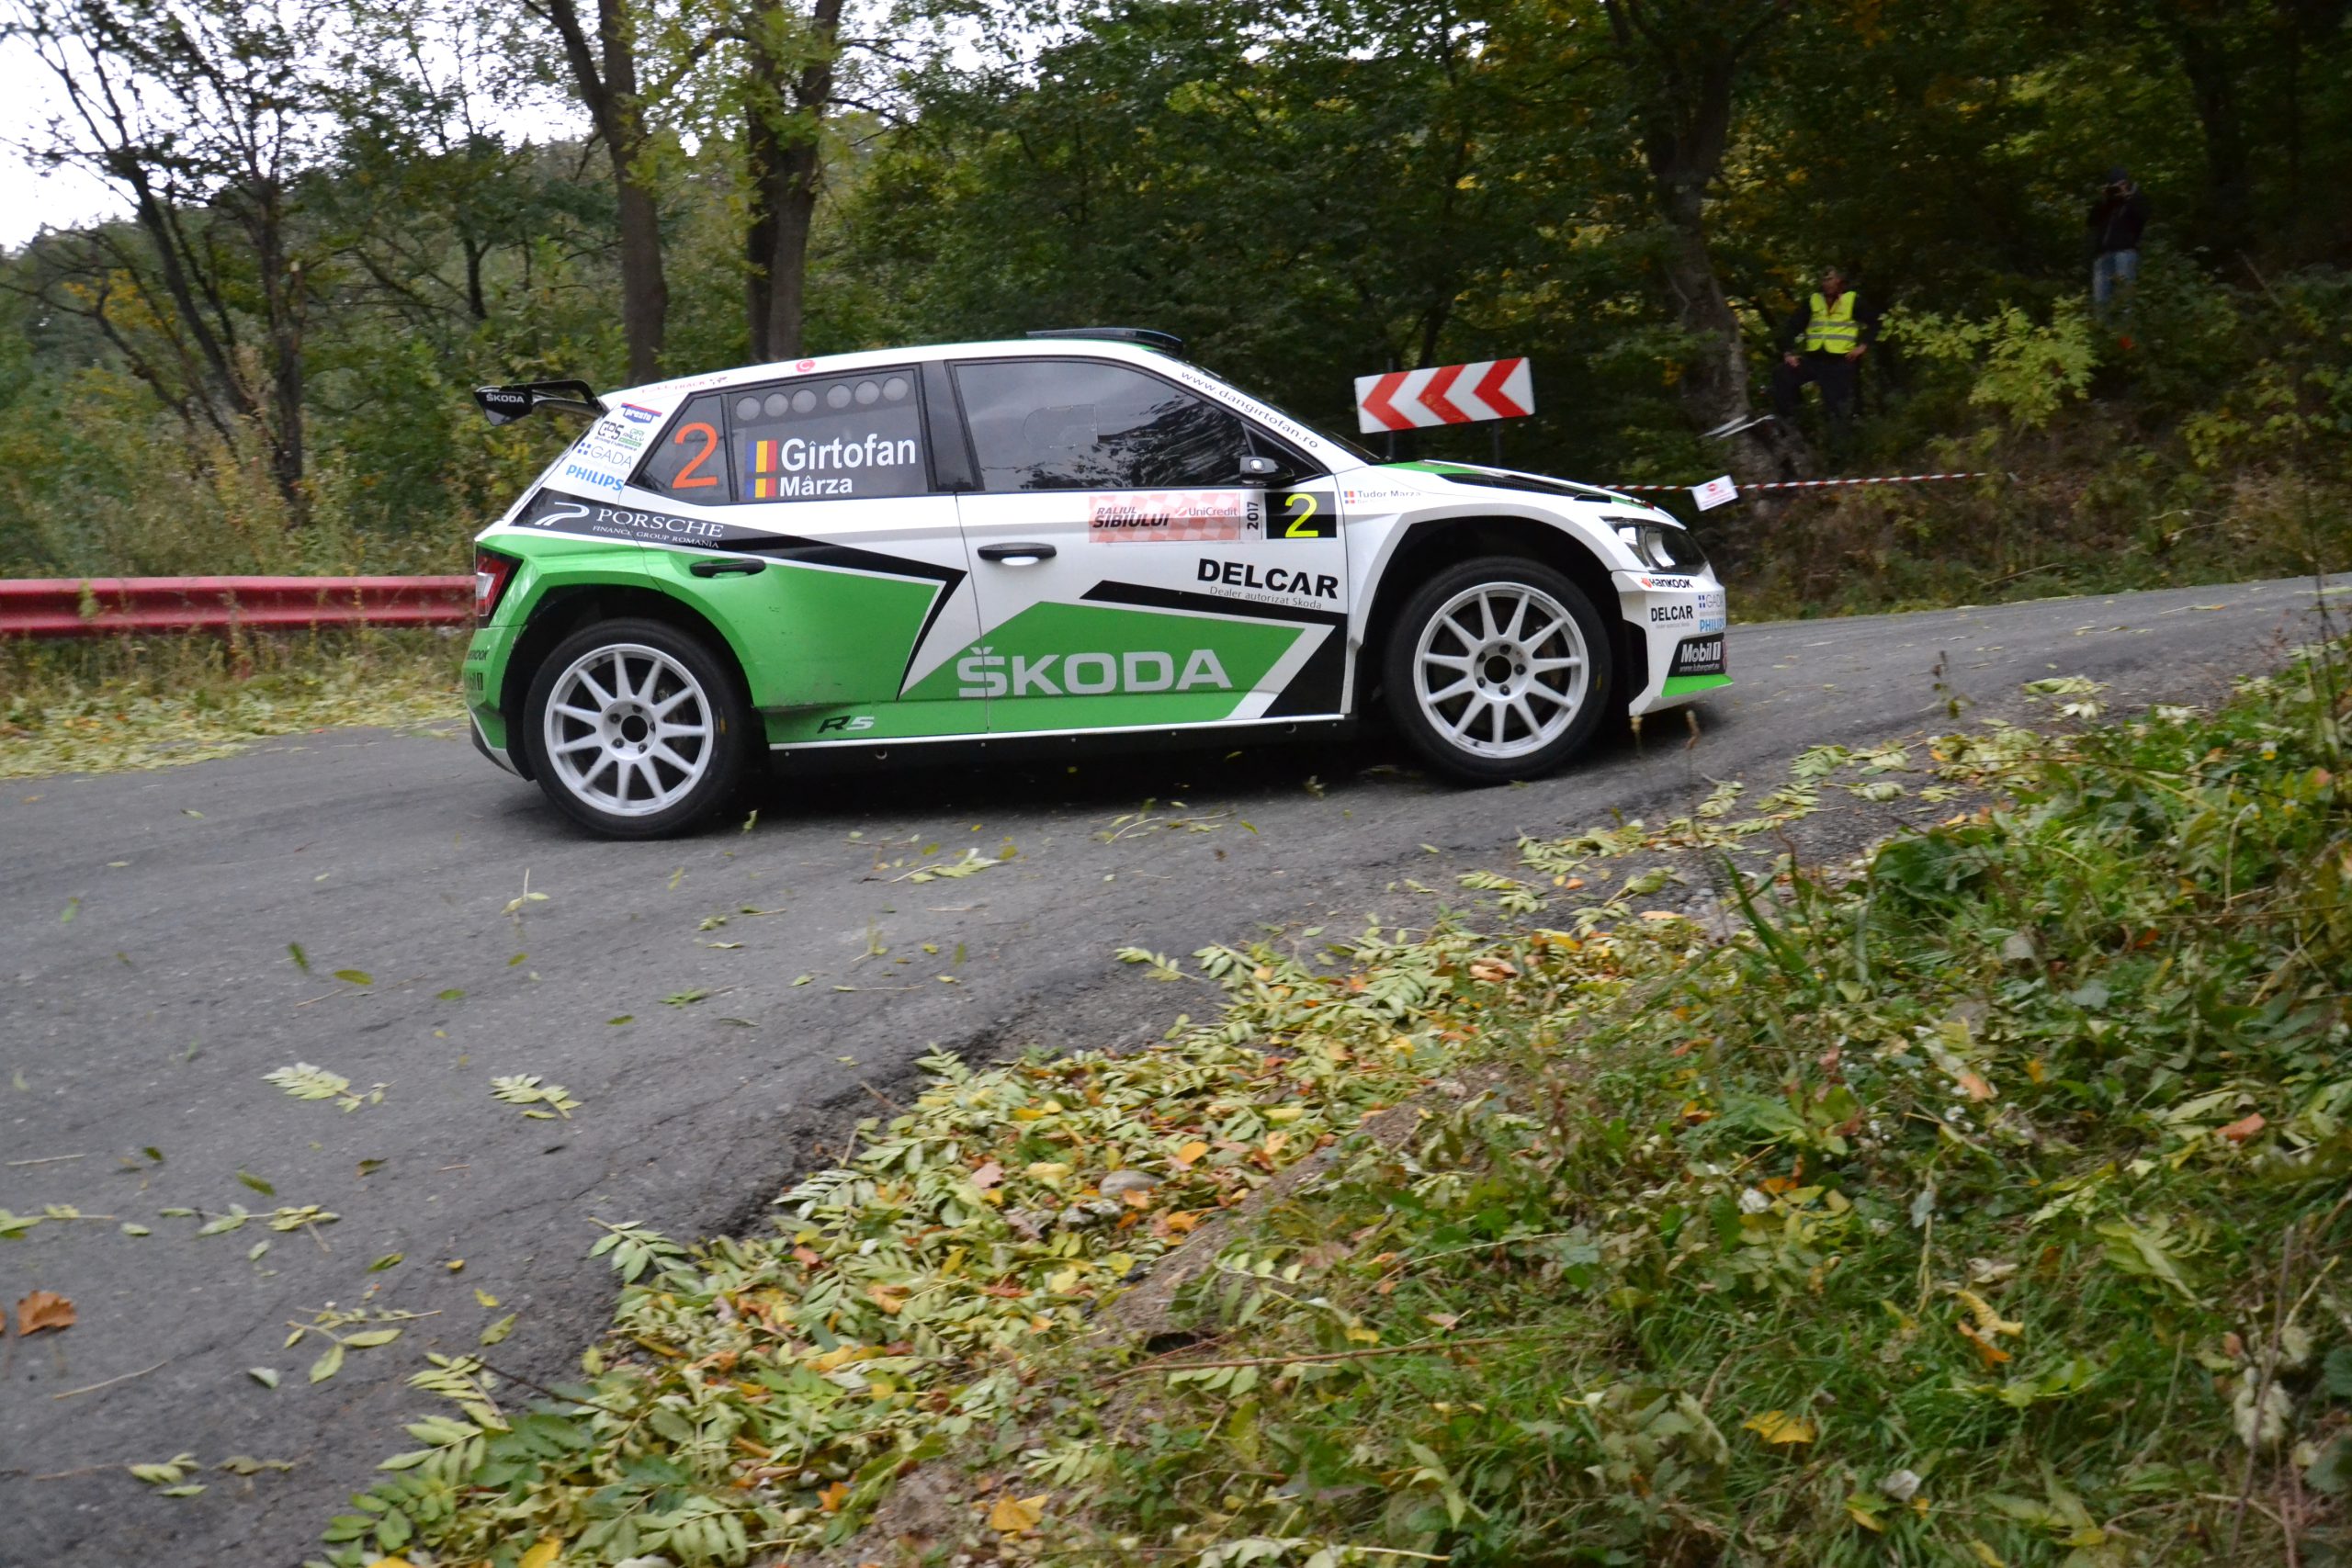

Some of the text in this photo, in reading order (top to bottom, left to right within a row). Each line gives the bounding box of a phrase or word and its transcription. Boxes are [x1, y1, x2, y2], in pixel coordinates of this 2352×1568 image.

[486, 392, 525, 403] ŠKODA
[1182, 371, 1318, 448] www.dangirtofan.ro
[591, 446, 632, 469] GADA
[672, 422, 718, 490] 2
[781, 434, 916, 472] Gîrtofan
[566, 464, 625, 491] PHILIPS
[779, 475, 853, 497] Mârza
[1358, 490, 1387, 498] Tudor
[1091, 513, 1171, 529] SIBIULUI
[1096, 506, 1137, 515] RALIUL
[1188, 506, 1238, 517] UniCredit
[1247, 501, 1260, 530] 2017
[1284, 493, 1319, 538] 2
[596, 508, 724, 538] PORSCHE
[636, 530, 670, 542] GROUP
[672, 536, 720, 549] ROMANIA
[1197, 558, 1339, 600] DELCAR
[1209, 585, 1242, 598] Dealer
[1244, 592, 1291, 605] autorizat
[1651, 605, 1693, 623] DELCAR
[1681, 642, 1712, 663] Mobil
[956, 646, 1233, 698] ŠKODA
